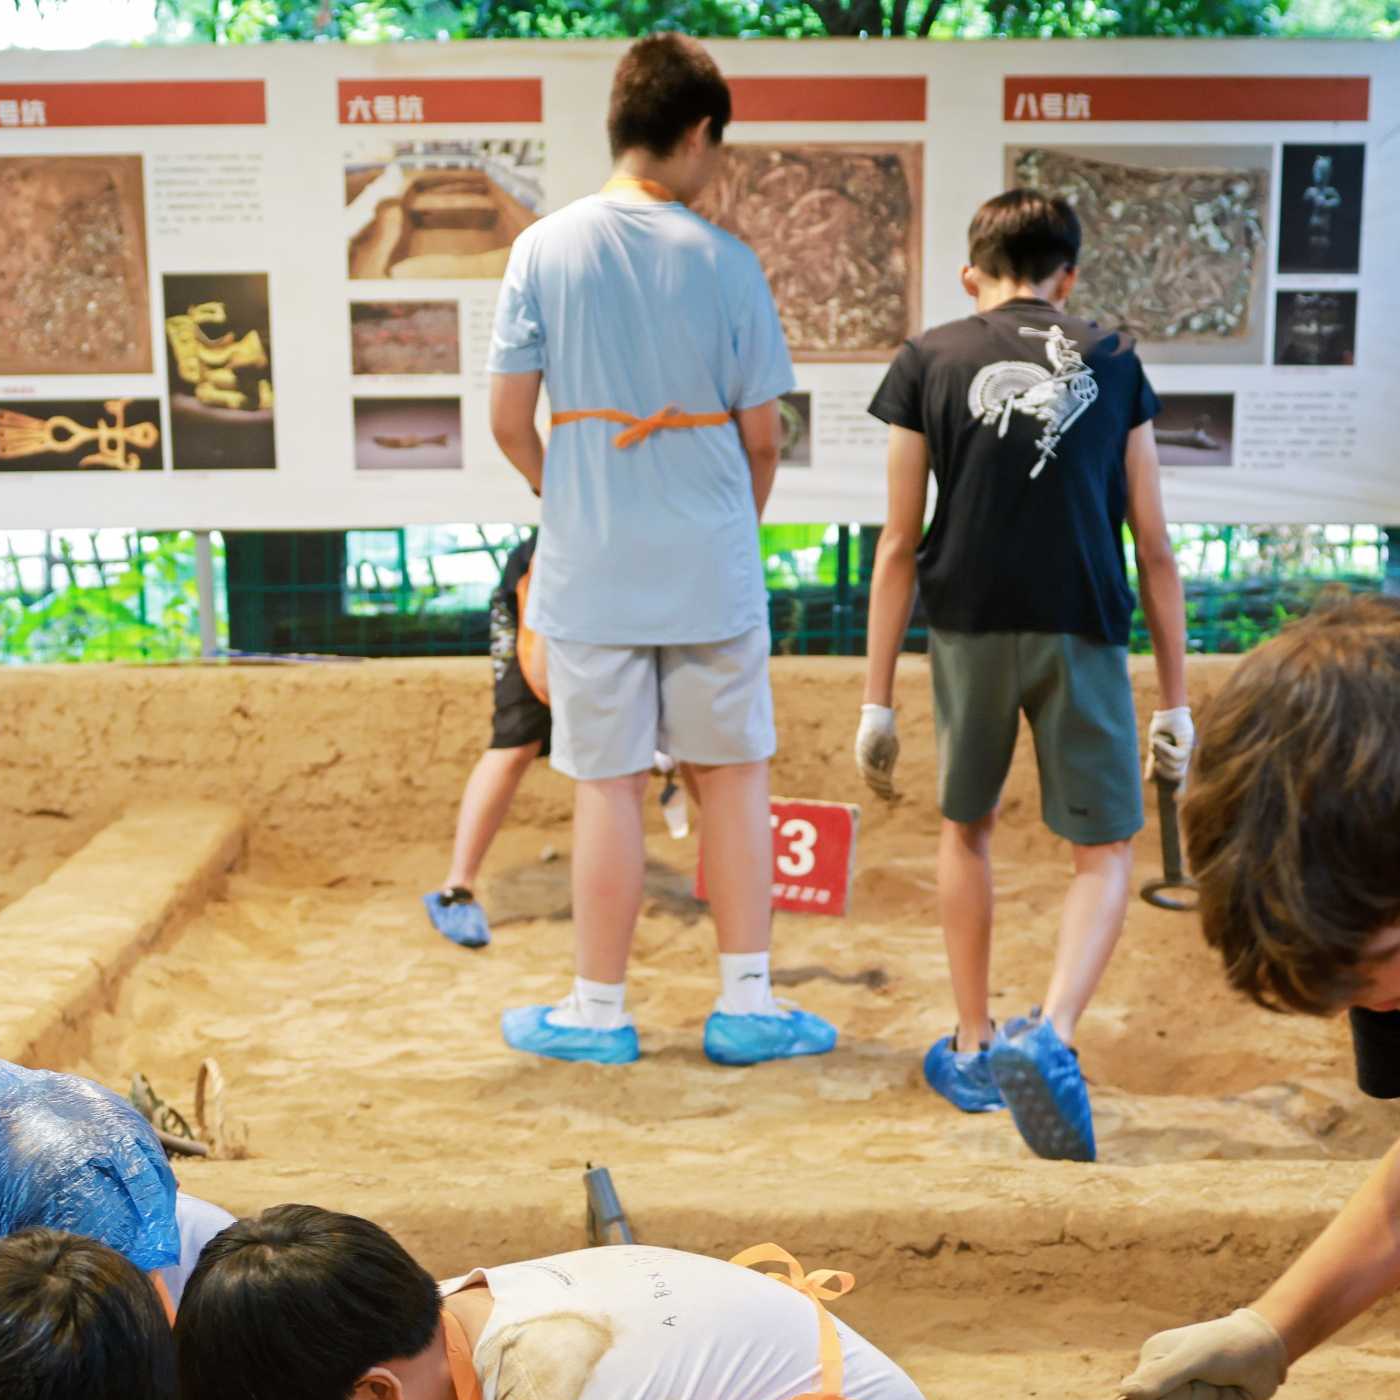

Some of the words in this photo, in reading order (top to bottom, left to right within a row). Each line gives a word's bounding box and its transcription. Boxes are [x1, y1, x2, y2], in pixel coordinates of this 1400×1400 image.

[347, 95, 425, 123] 六号坑
[1013, 93, 1091, 120] 八号坑
